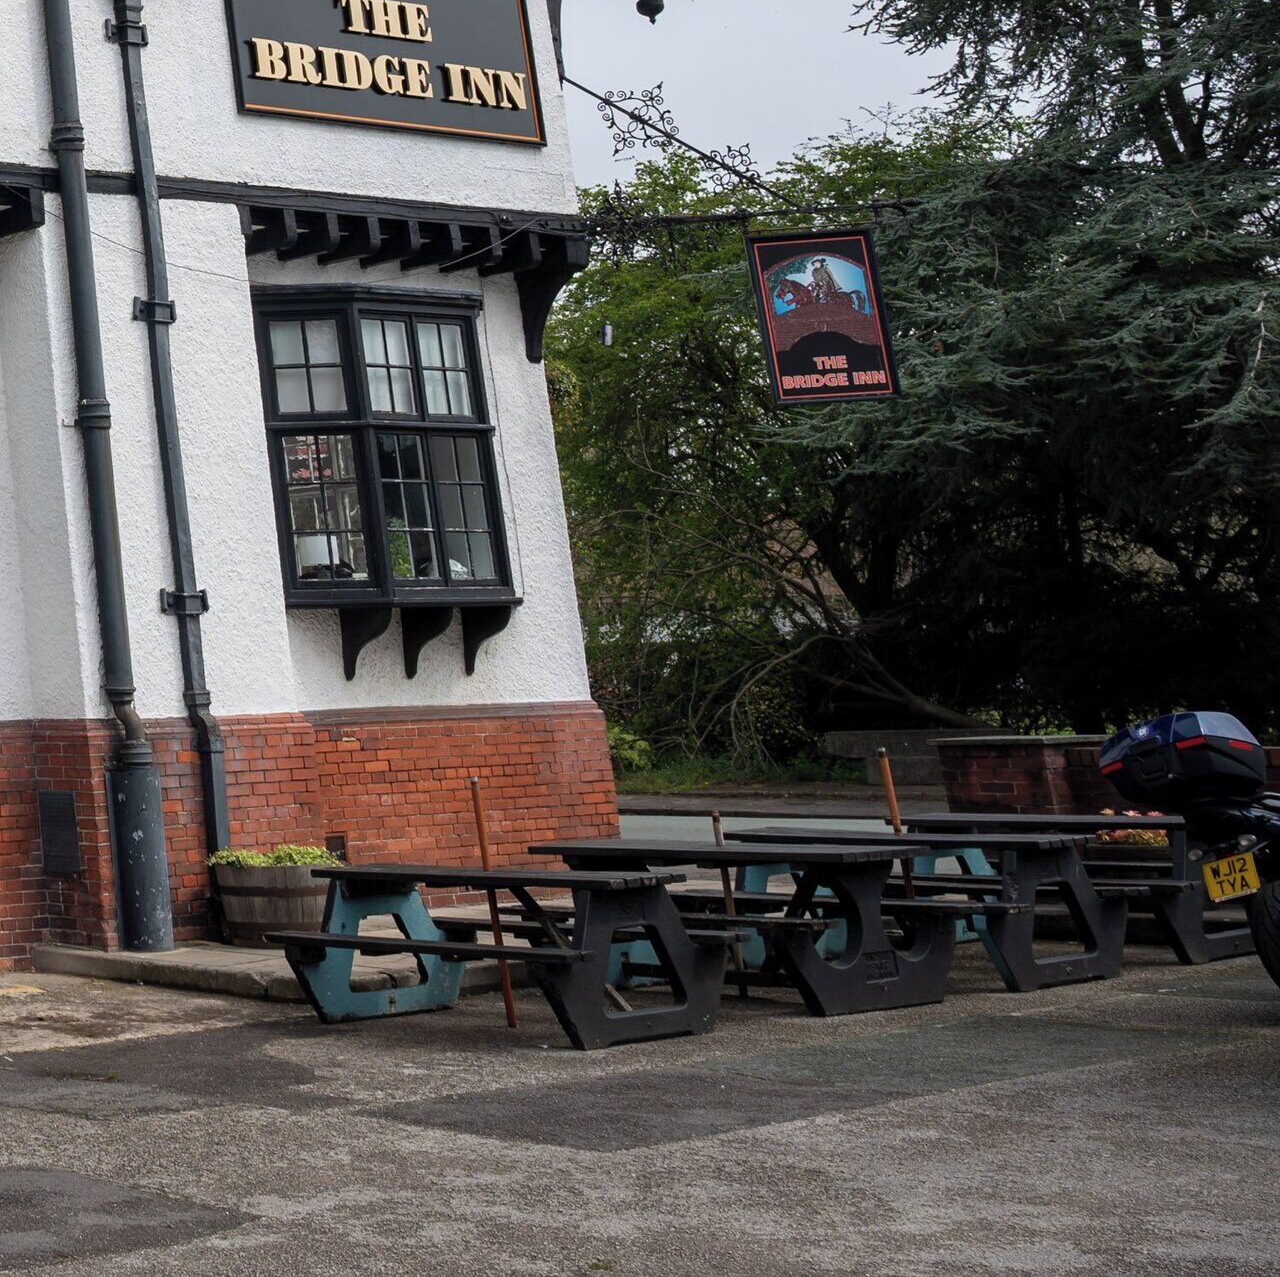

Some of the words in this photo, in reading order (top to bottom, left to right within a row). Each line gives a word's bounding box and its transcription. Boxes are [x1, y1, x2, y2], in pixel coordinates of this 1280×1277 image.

[251, 37, 434, 98] BRIDGE
[444, 63, 527, 110] INN
[813, 355, 848, 370] THE
[782, 373, 849, 390] BRIDGE
[853, 370, 887, 385] INN
[1210, 857, 1249, 880] WJ12
[1216, 875, 1250, 895] TYA
